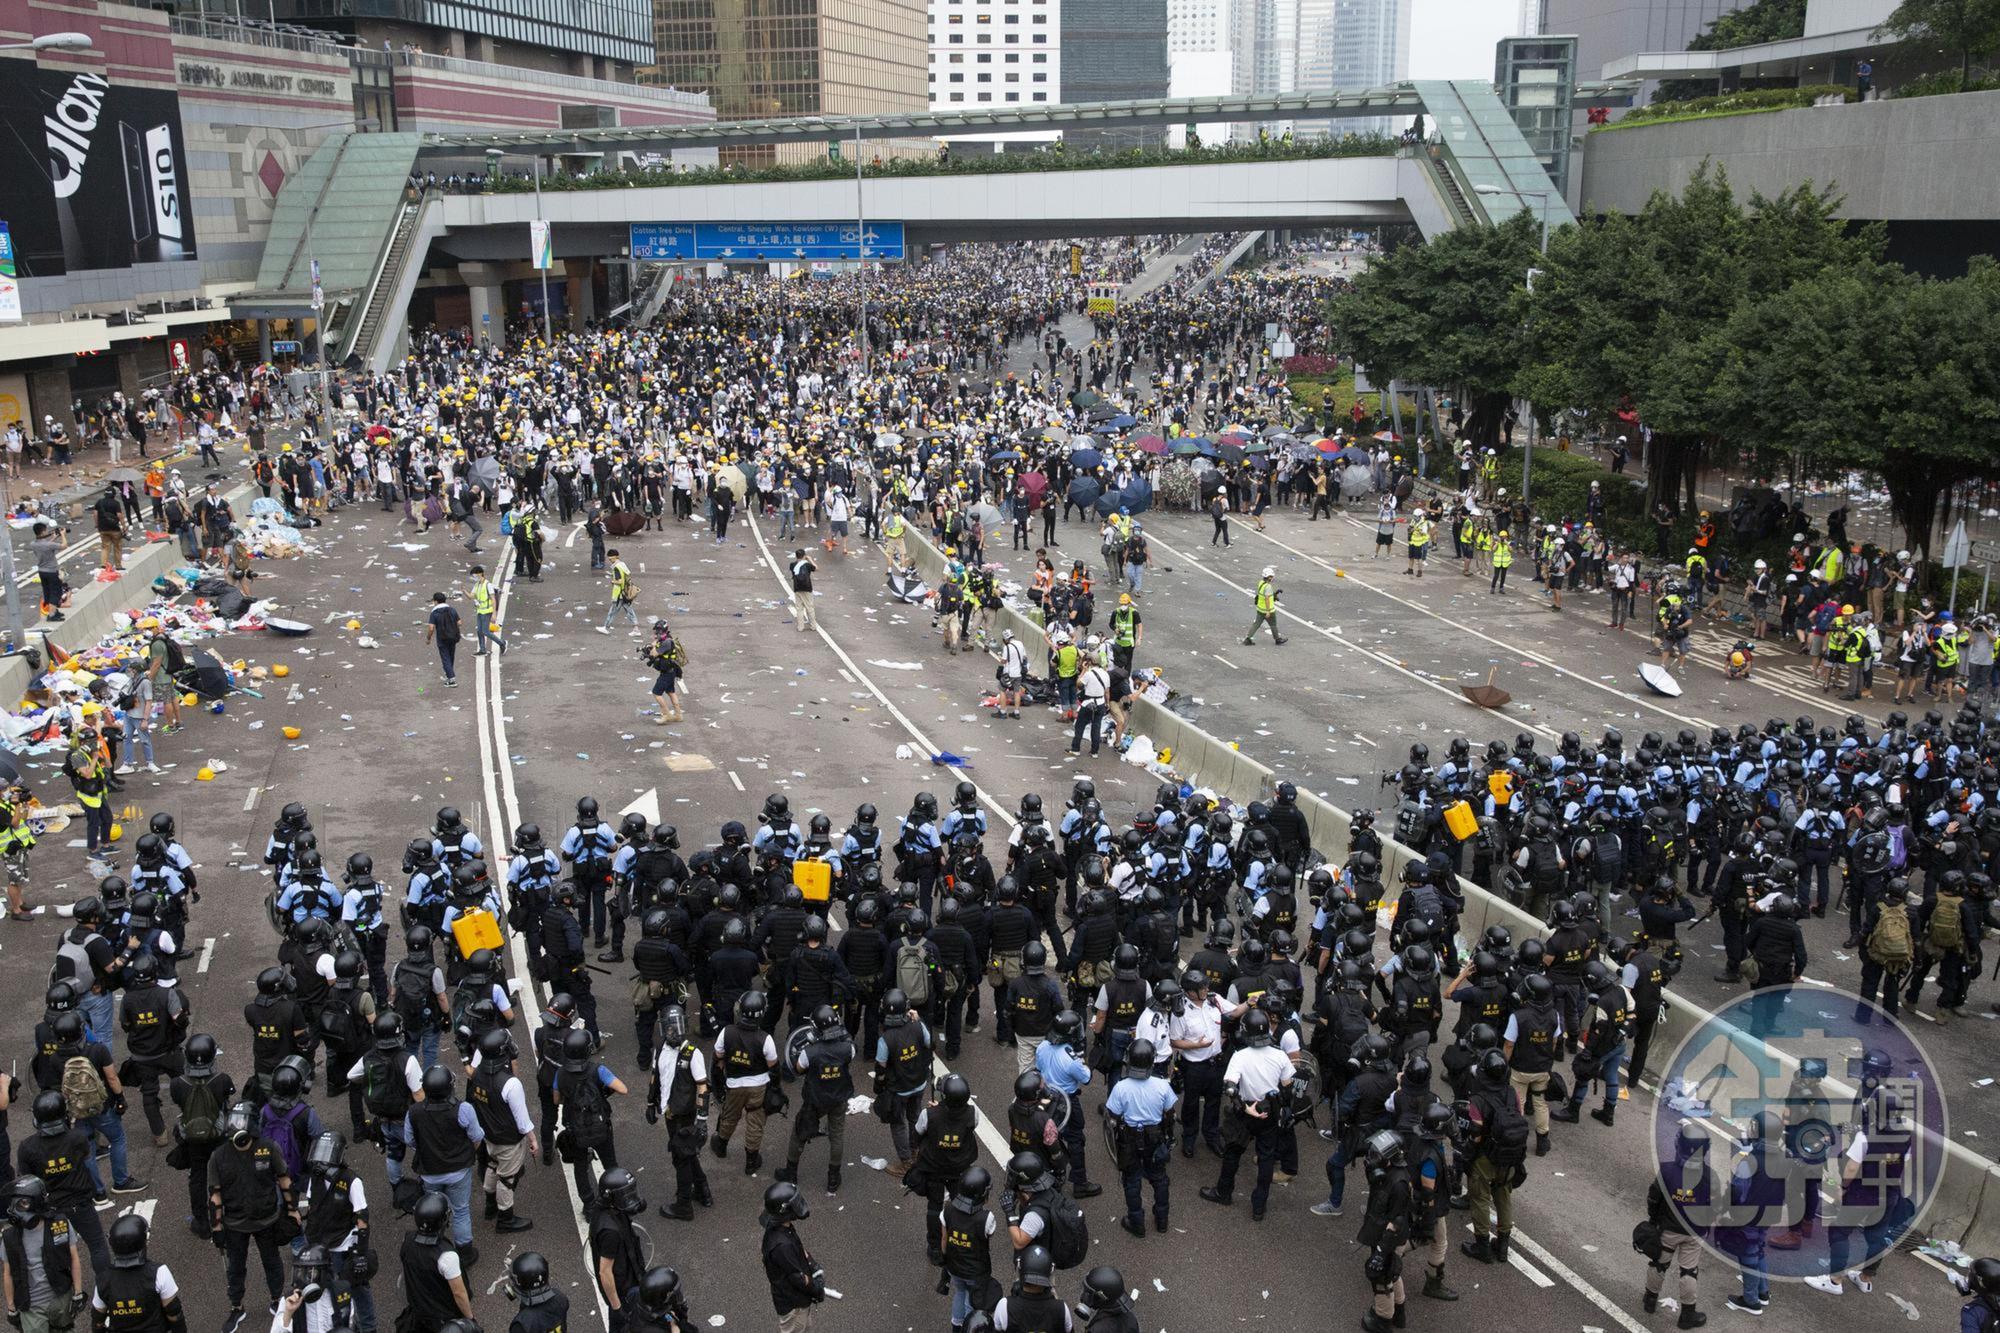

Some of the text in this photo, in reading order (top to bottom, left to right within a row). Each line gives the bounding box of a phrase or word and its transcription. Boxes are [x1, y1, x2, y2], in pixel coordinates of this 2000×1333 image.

[155, 148, 179, 219] S10
[747, 225, 772, 234] Sheung
[793, 225, 821, 233] Kowloon
[824, 225, 839, 233] (W)
[1407, 813, 1416, 835] POLICE
[137, 1017, 158, 1025] POLICE
[731, 1056, 751, 1066] POLICE
[900, 1051, 917, 1061] POLICE
[821, 1072, 841, 1080] POLICE
[939, 1140, 960, 1148] POLICE
[45, 1163, 72, 1175] POLICE
[948, 1236, 971, 1248] POLICE
[113, 1307, 142, 1316] POLICE
